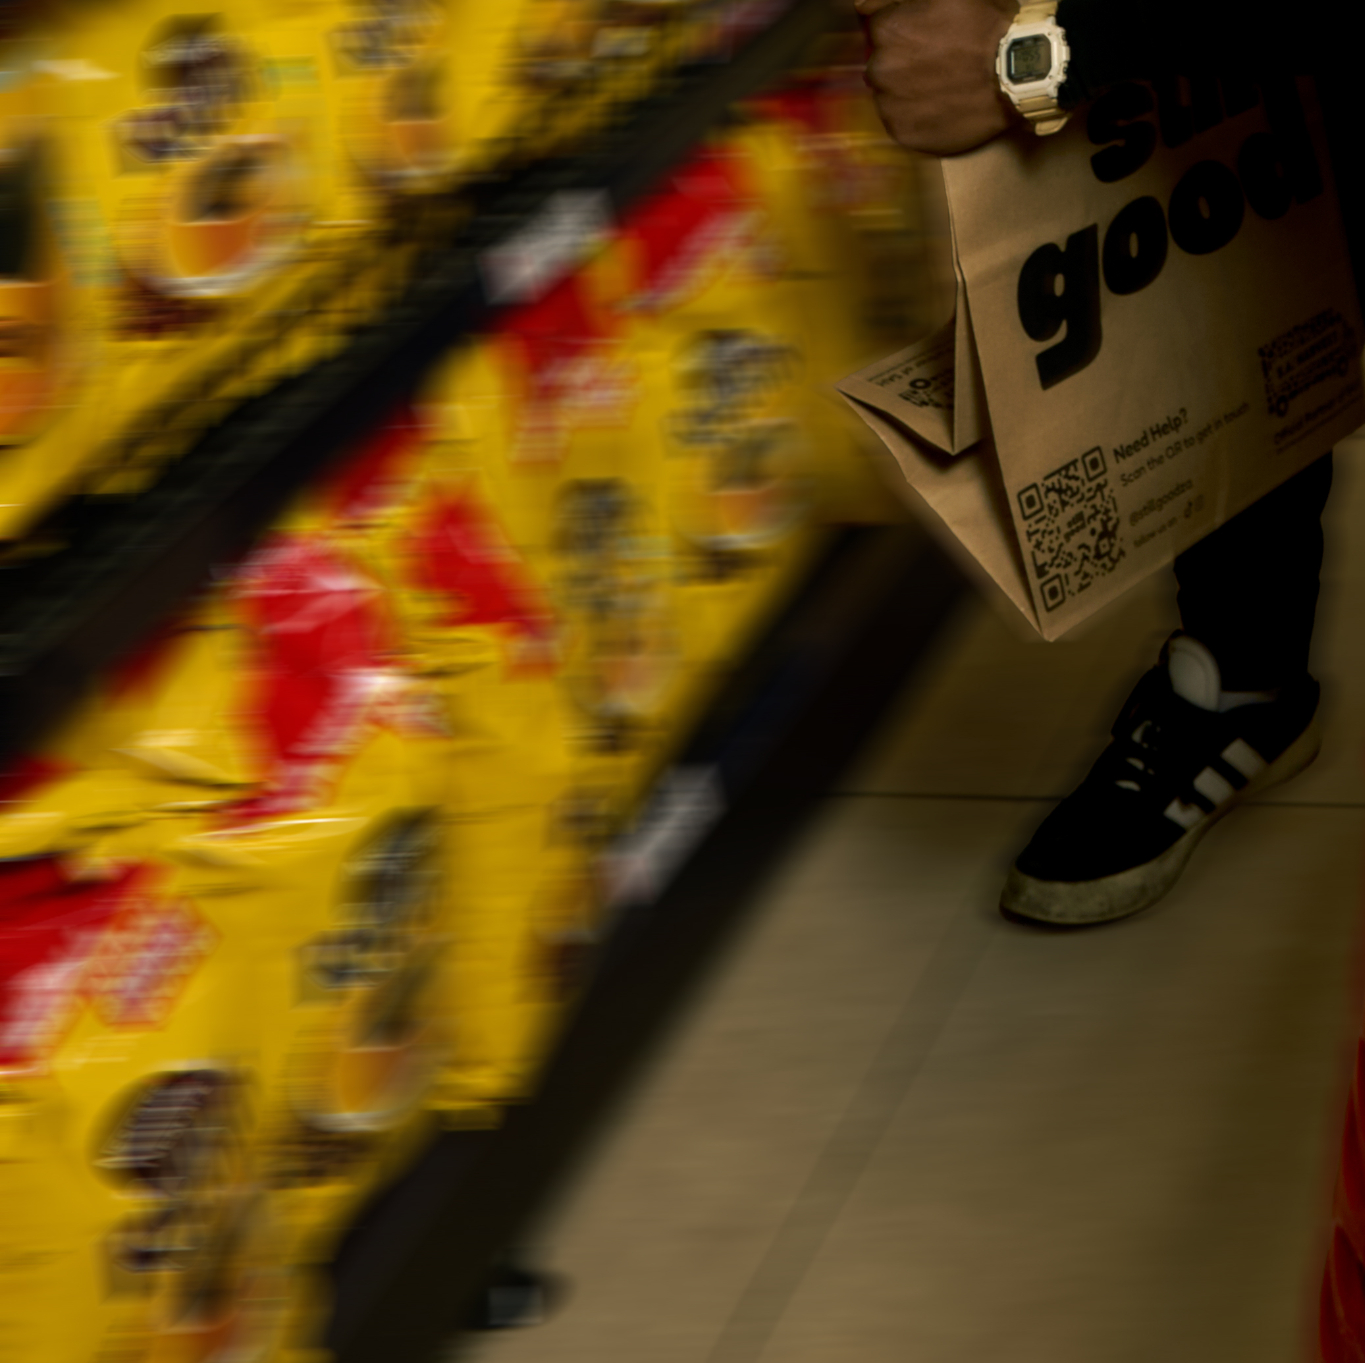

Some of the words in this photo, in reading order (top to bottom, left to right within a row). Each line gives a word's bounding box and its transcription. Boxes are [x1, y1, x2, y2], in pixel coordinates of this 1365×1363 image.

[1016, 131, 1325, 391] good
[1112, 432, 1150, 464] Need
[1149, 407, 1188, 445] Help?
